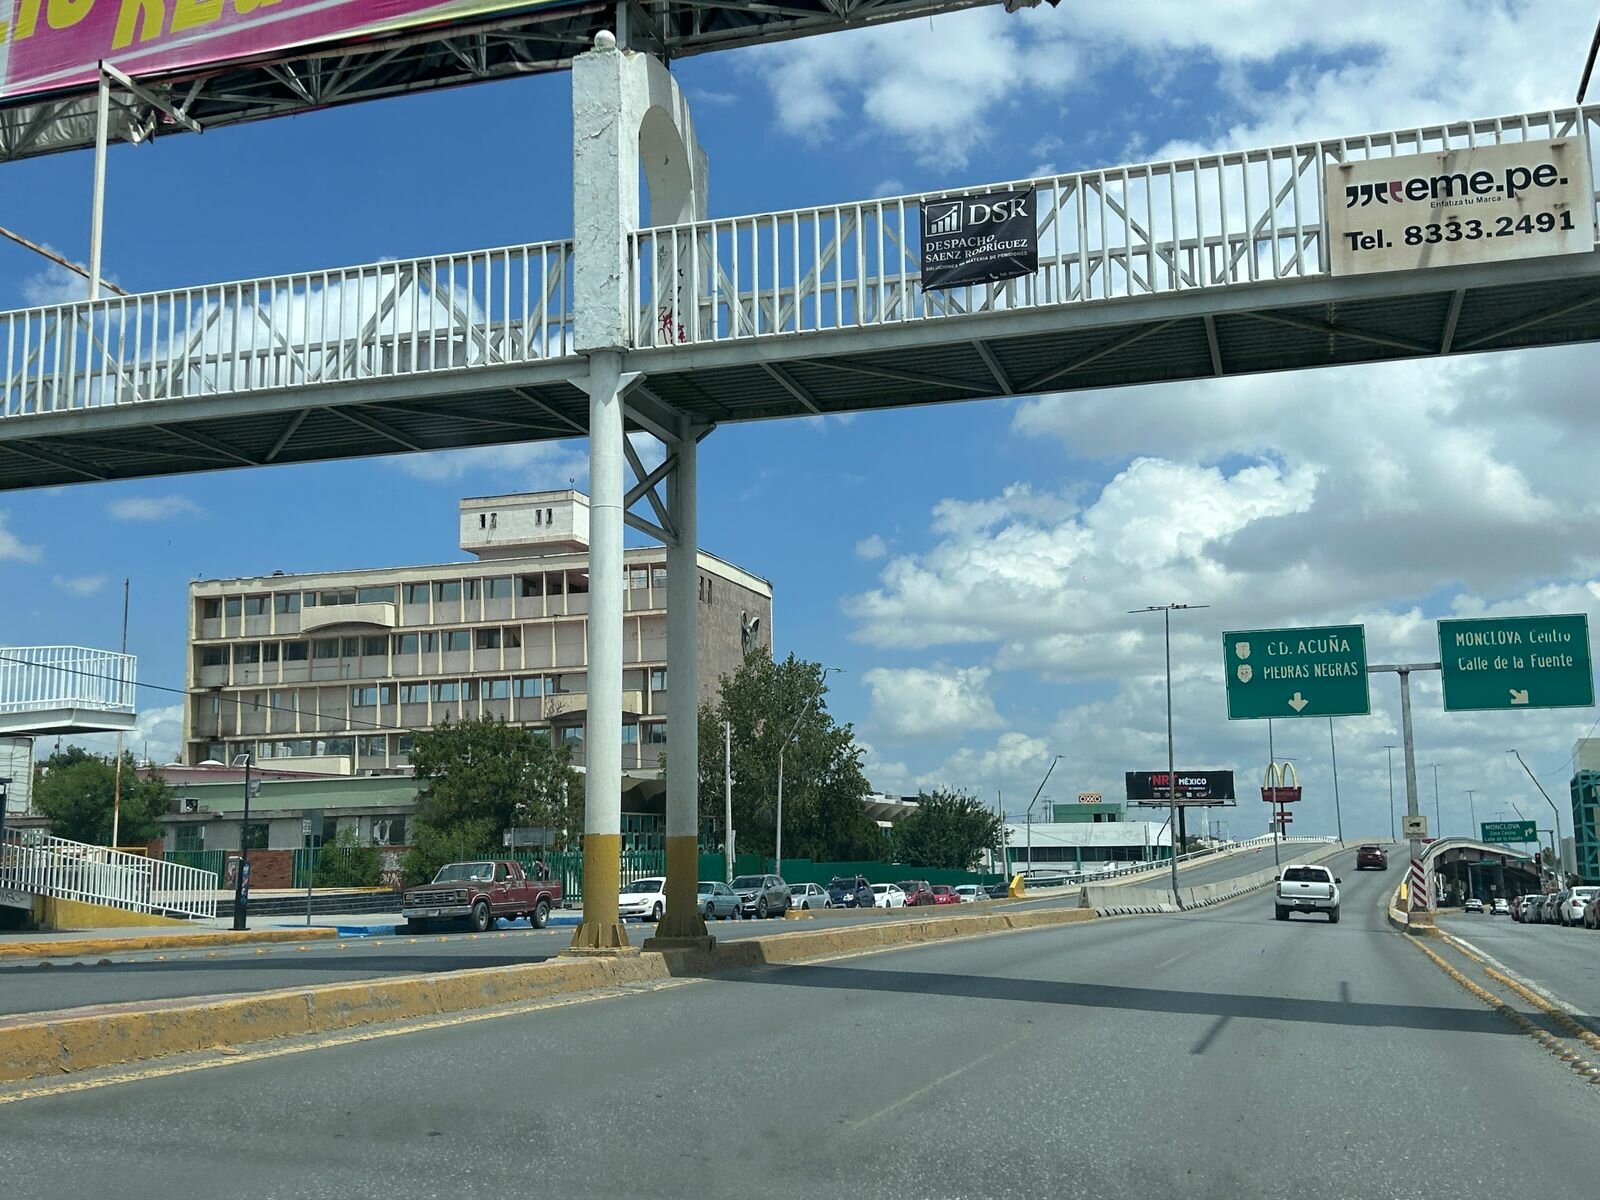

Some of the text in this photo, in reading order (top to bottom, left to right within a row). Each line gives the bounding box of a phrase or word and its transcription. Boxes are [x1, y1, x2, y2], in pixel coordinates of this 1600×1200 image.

[1405, 163, 1568, 202] eme.pe.
[968, 198, 1028, 226] DSR
[1430, 198, 1464, 209] Enfatiza
[1464, 197, 1474, 205] tu
[1347, 210, 1575, 251] Tel. 8333.2491
[925, 239, 1028, 263] SAENZ RODRÍGUEZ
[926, 234, 995, 252] DESPACHO
[1267, 634, 1351, 656] CD. ACUÑA
[1455, 630, 1522, 647] MONCLOVA
[1263, 661, 1358, 680] PIEDRAS NEGRAS
[1458, 653, 1573, 671] Calle de la Fuente
[1152, 774, 1207, 786] NR MÉXICO
[1079, 795, 1101, 803] OXXO
